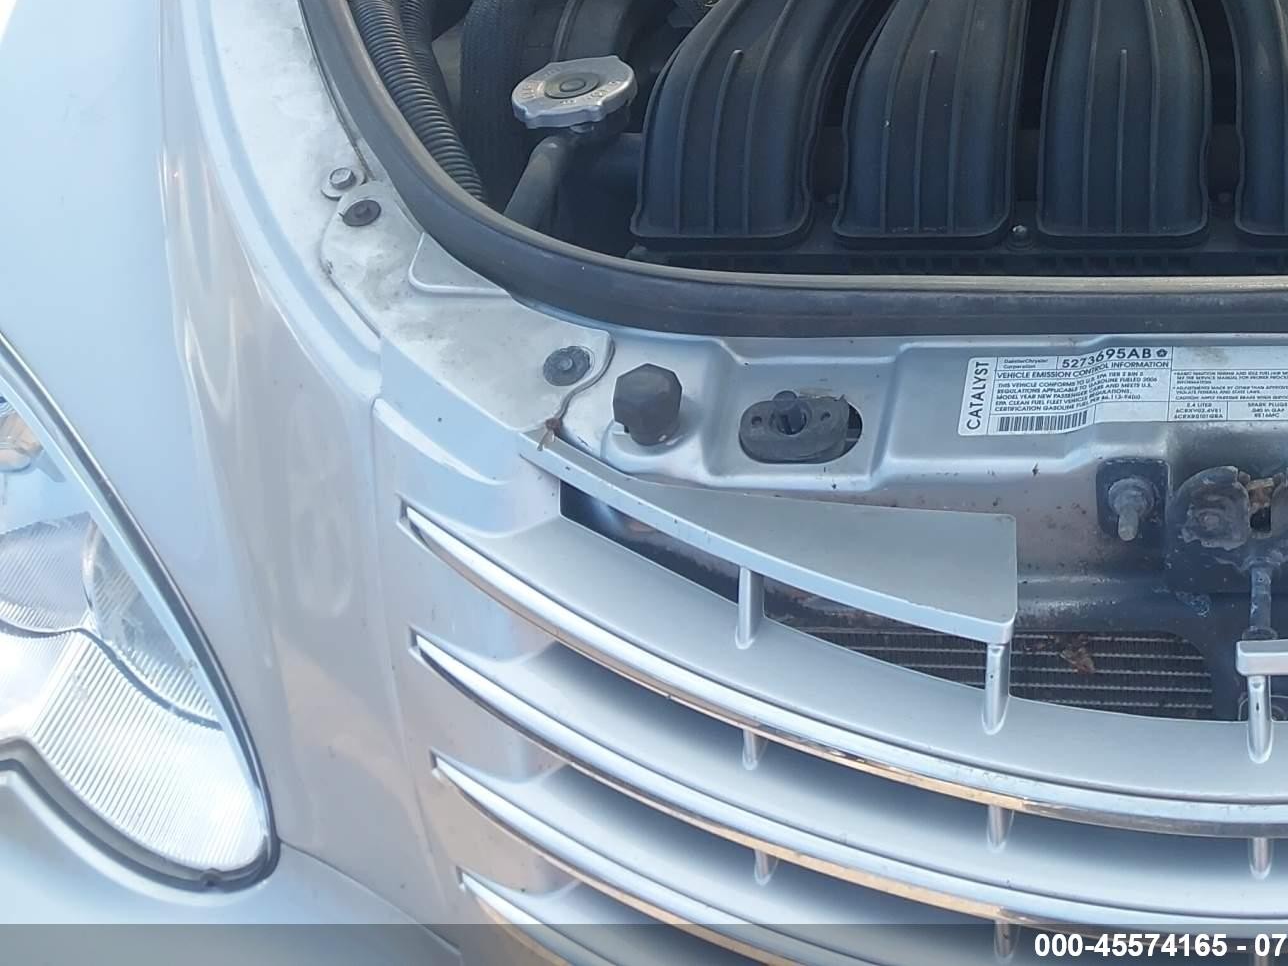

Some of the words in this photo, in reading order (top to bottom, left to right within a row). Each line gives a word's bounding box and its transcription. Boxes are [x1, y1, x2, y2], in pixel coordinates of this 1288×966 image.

[1062, 348, 1152, 368] 5273695AB
[997, 371, 1029, 379] VEHICLE
[1073, 362, 1108, 377] CONTROL
[966, 361, 989, 430] CATALYST
